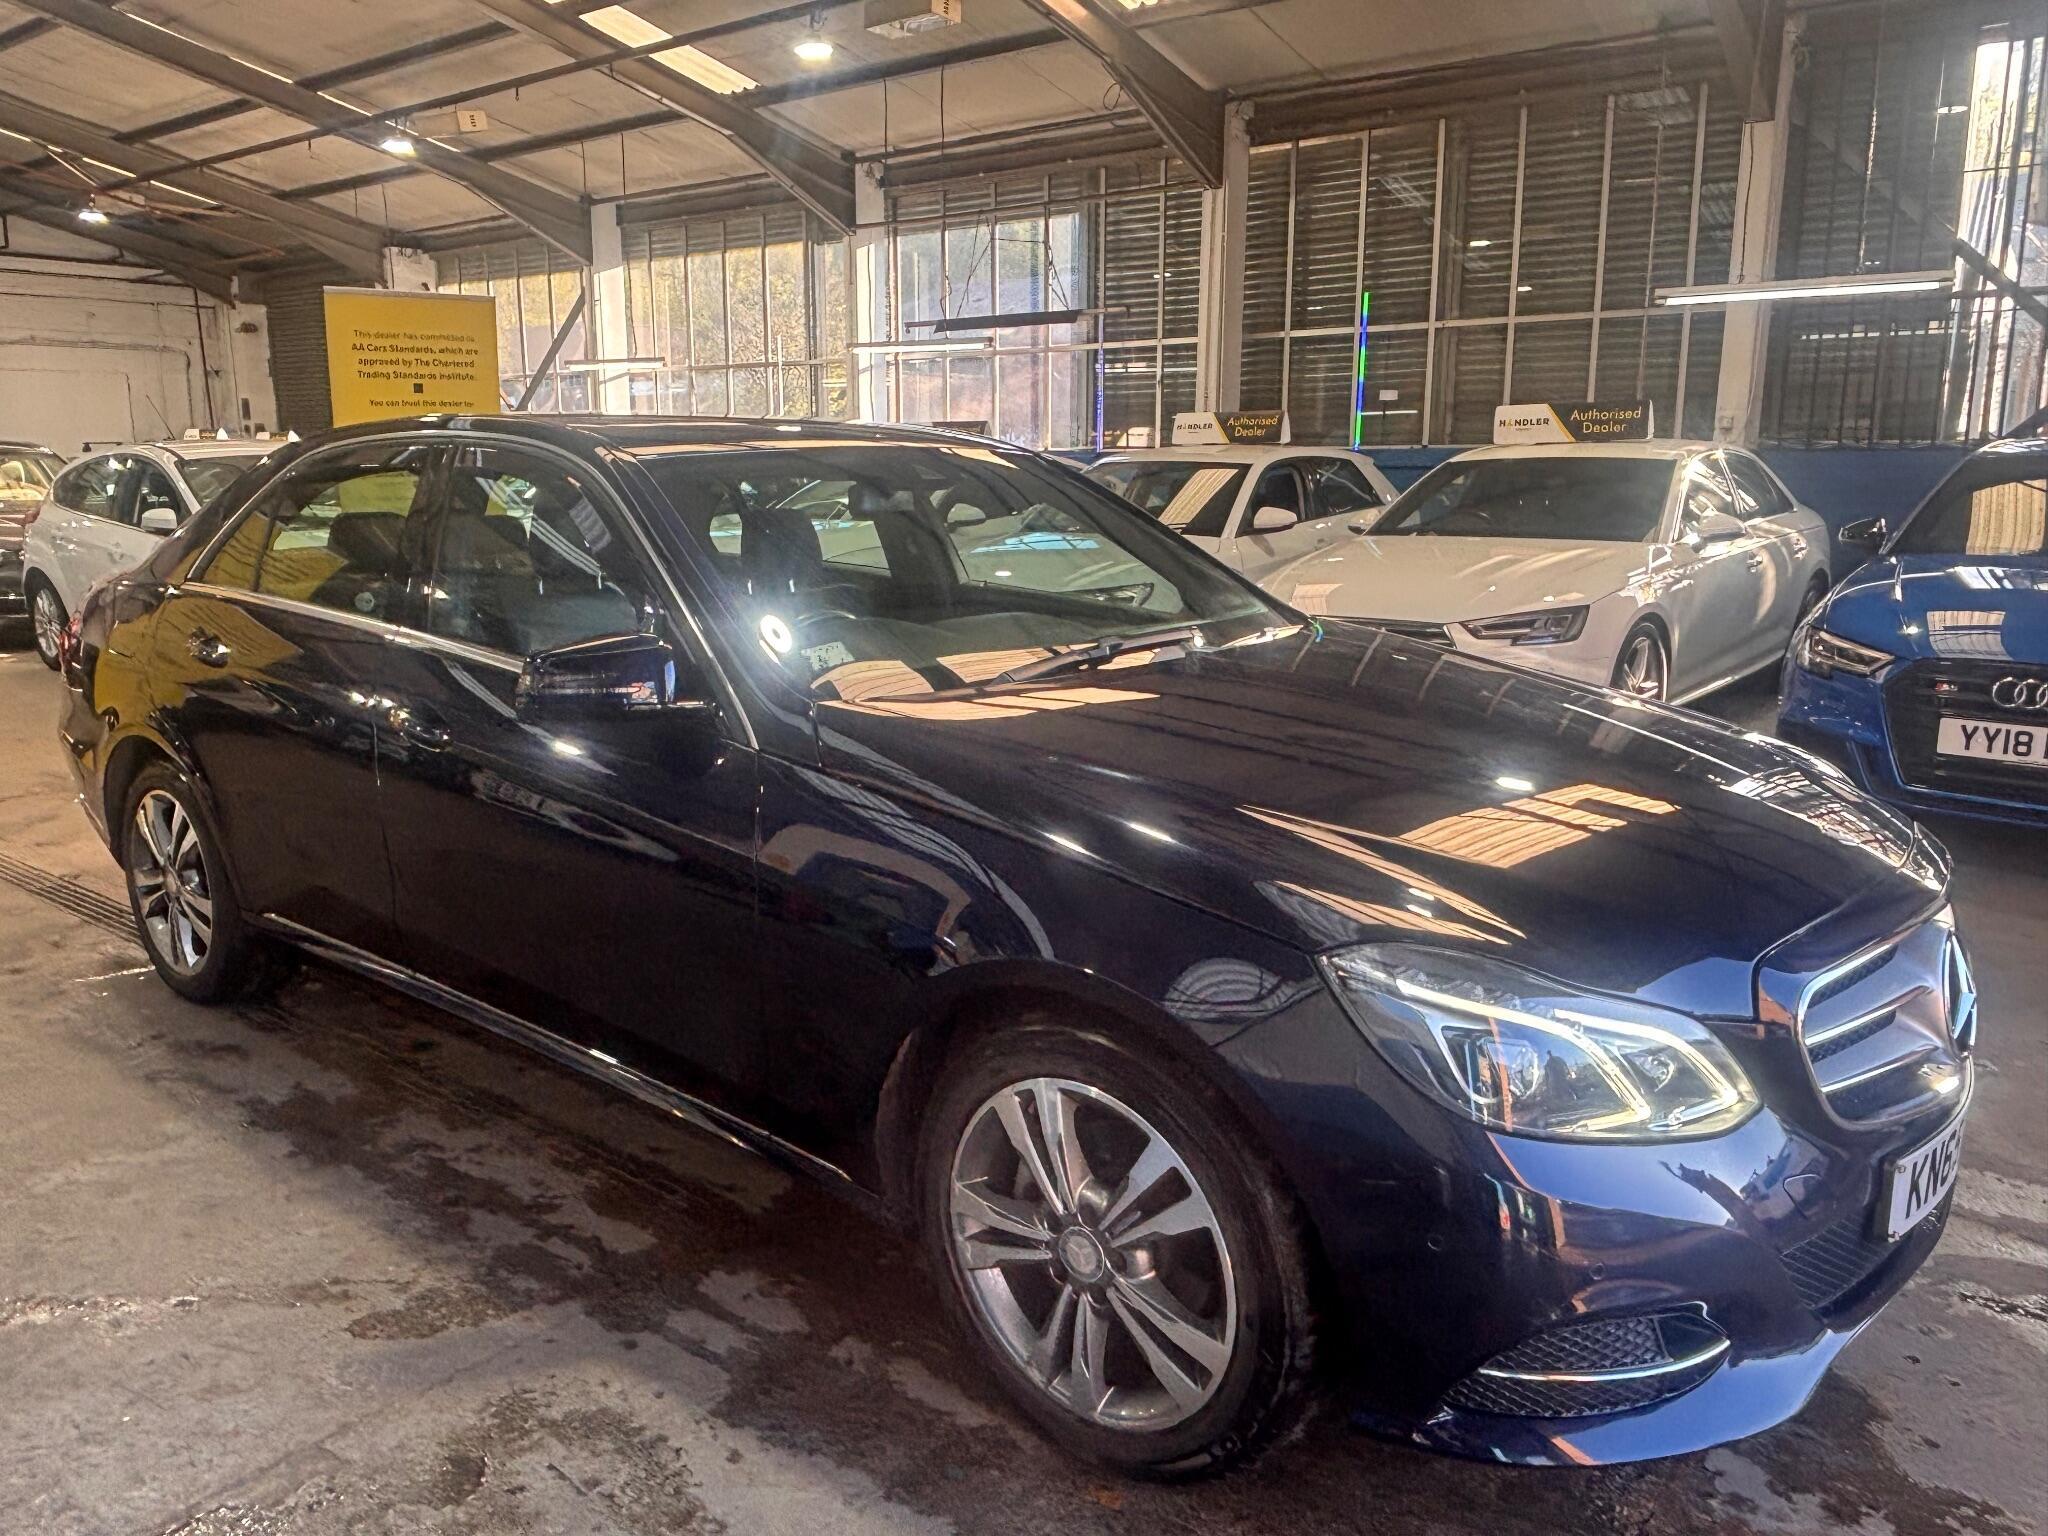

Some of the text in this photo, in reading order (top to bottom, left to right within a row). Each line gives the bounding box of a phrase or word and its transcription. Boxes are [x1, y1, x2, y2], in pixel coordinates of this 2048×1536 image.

[374, 331, 400, 339] dealer
[351, 343, 365, 351] AA
[366, 343, 388, 352] Cars
[438, 346, 464, 355] which
[358, 358, 475, 368] approved by The Chartered
[357, 370, 391, 380] Trading
[392, 370, 437, 380] Standards
[369, 399, 384, 407] You
[401, 399, 420, 407] trust
[438, 400, 462, 408] dealer
[1569, 406, 1643, 421] Authorised
[1227, 415, 1280, 426] Authorised
[1234, 427, 1267, 437] Dealer
[1582, 421, 1628, 434] Dealer
[1961, 724, 2034, 757] YY18
